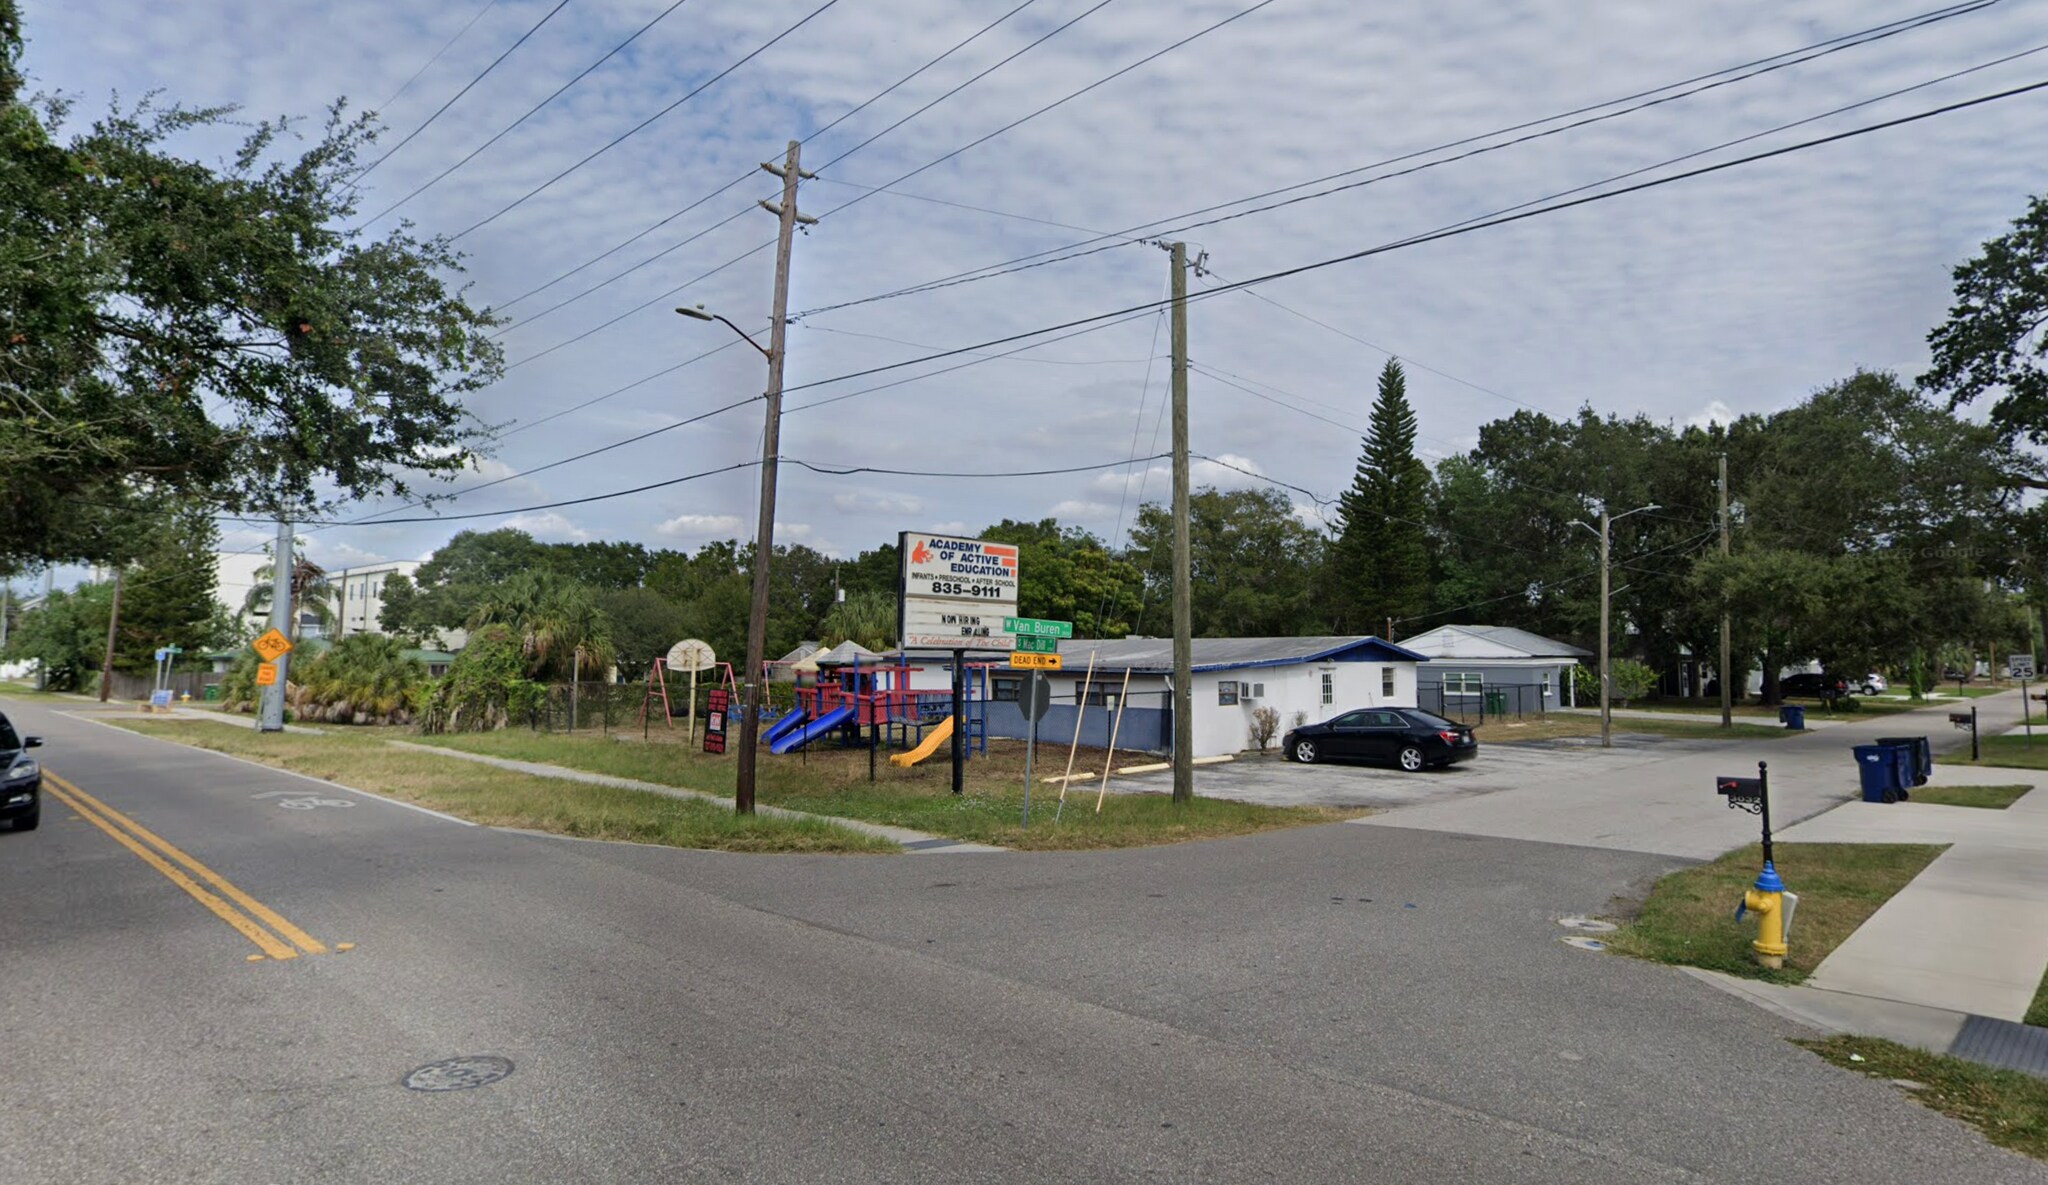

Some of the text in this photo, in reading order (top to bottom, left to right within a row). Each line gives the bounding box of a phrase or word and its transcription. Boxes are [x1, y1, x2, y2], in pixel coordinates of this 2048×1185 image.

[929, 539, 981, 553] ACADEMY
[940, 551, 999, 565] OF ACTIVE
[951, 563, 1010, 577] EDUCATION
[912, 572, 1015, 587] INFANTS PRESCHOOL AFTER SCHOOL
[932, 582, 1000, 597] 835-9111
[1013, 619, 1030, 632] Van
[1034, 621, 1060, 635] Buren
[920, 636, 962, 646] Celebration
[975, 638, 988, 647] The
[1014, 655, 1046, 665] DEAD END
[2012, 667, 2034, 678] 25
